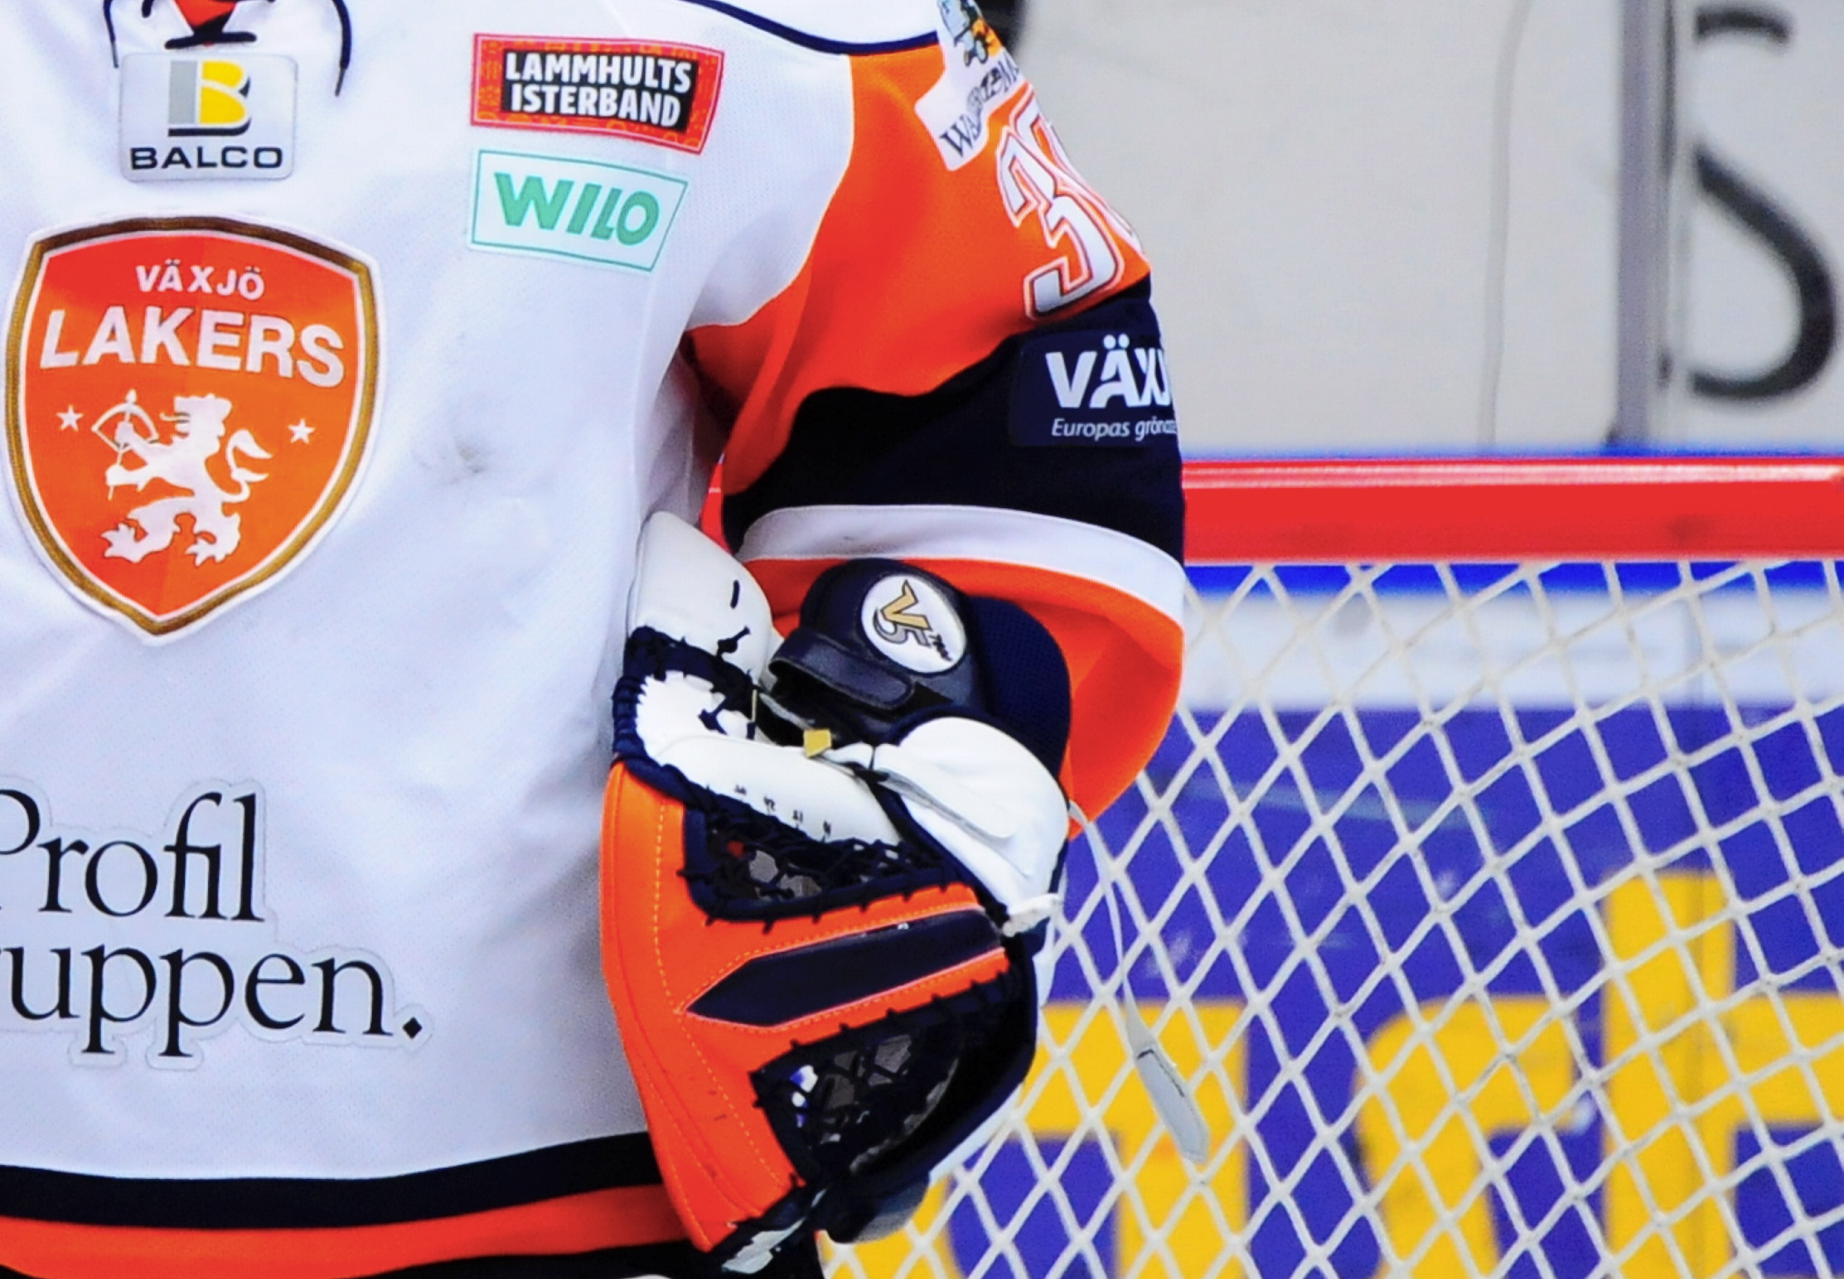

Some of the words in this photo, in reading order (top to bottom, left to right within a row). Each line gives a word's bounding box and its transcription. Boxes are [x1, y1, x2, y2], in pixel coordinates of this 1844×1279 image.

[505, 51, 693, 95] LAMMHULTS
[510, 83, 682, 129] ISTERBAND
[130, 145, 284, 171] BALCO
[494, 171, 662, 247] WILO
[135, 260, 267, 301] VÄXJÖ
[40, 306, 346, 389] LAKERS
[1051, 417, 1131, 441] Europas
